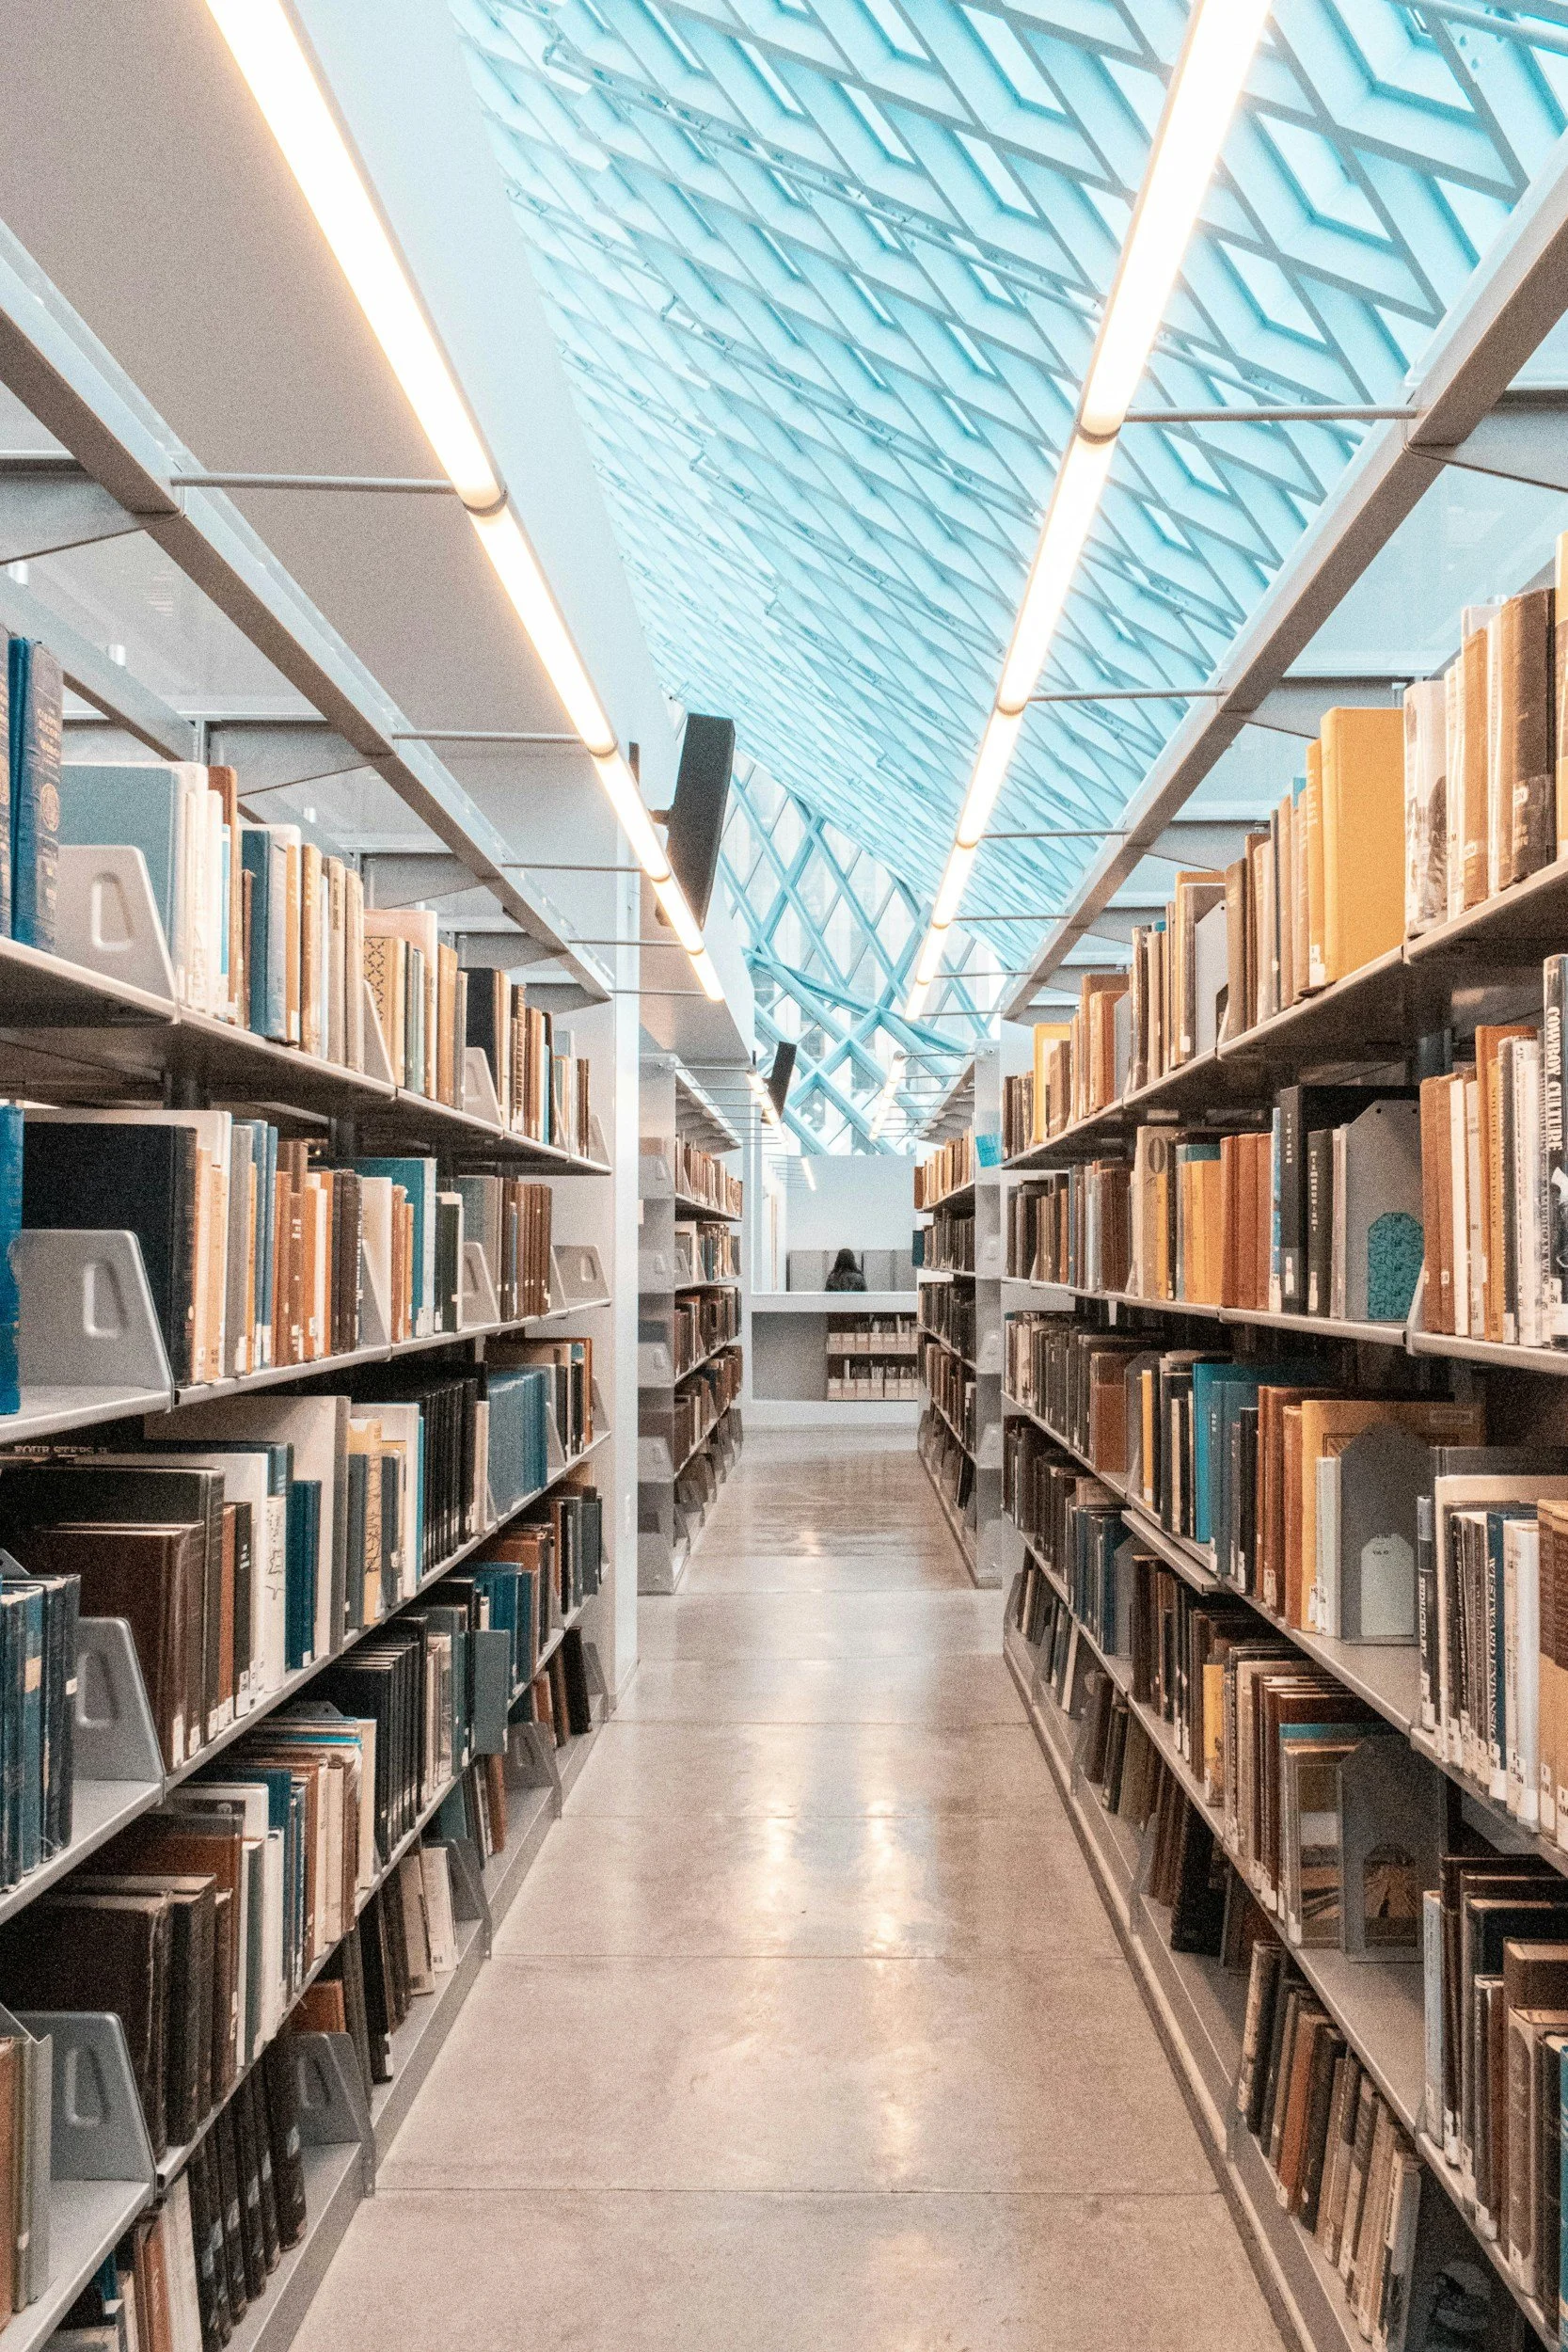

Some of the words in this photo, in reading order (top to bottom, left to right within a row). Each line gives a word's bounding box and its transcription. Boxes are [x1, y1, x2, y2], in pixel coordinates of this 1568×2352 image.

[1546, 1006, 1561, 1076] COWBOY
[1547, 1081, 1563, 1152] CULTURE
[1541, 1186, 1549, 1254] AMERICAN
[1418, 1577, 1427, 1636] SEDUCED
[1488, 1556, 1497, 1654] WESTWARD
[1420, 1639, 1428, 1657] BY
